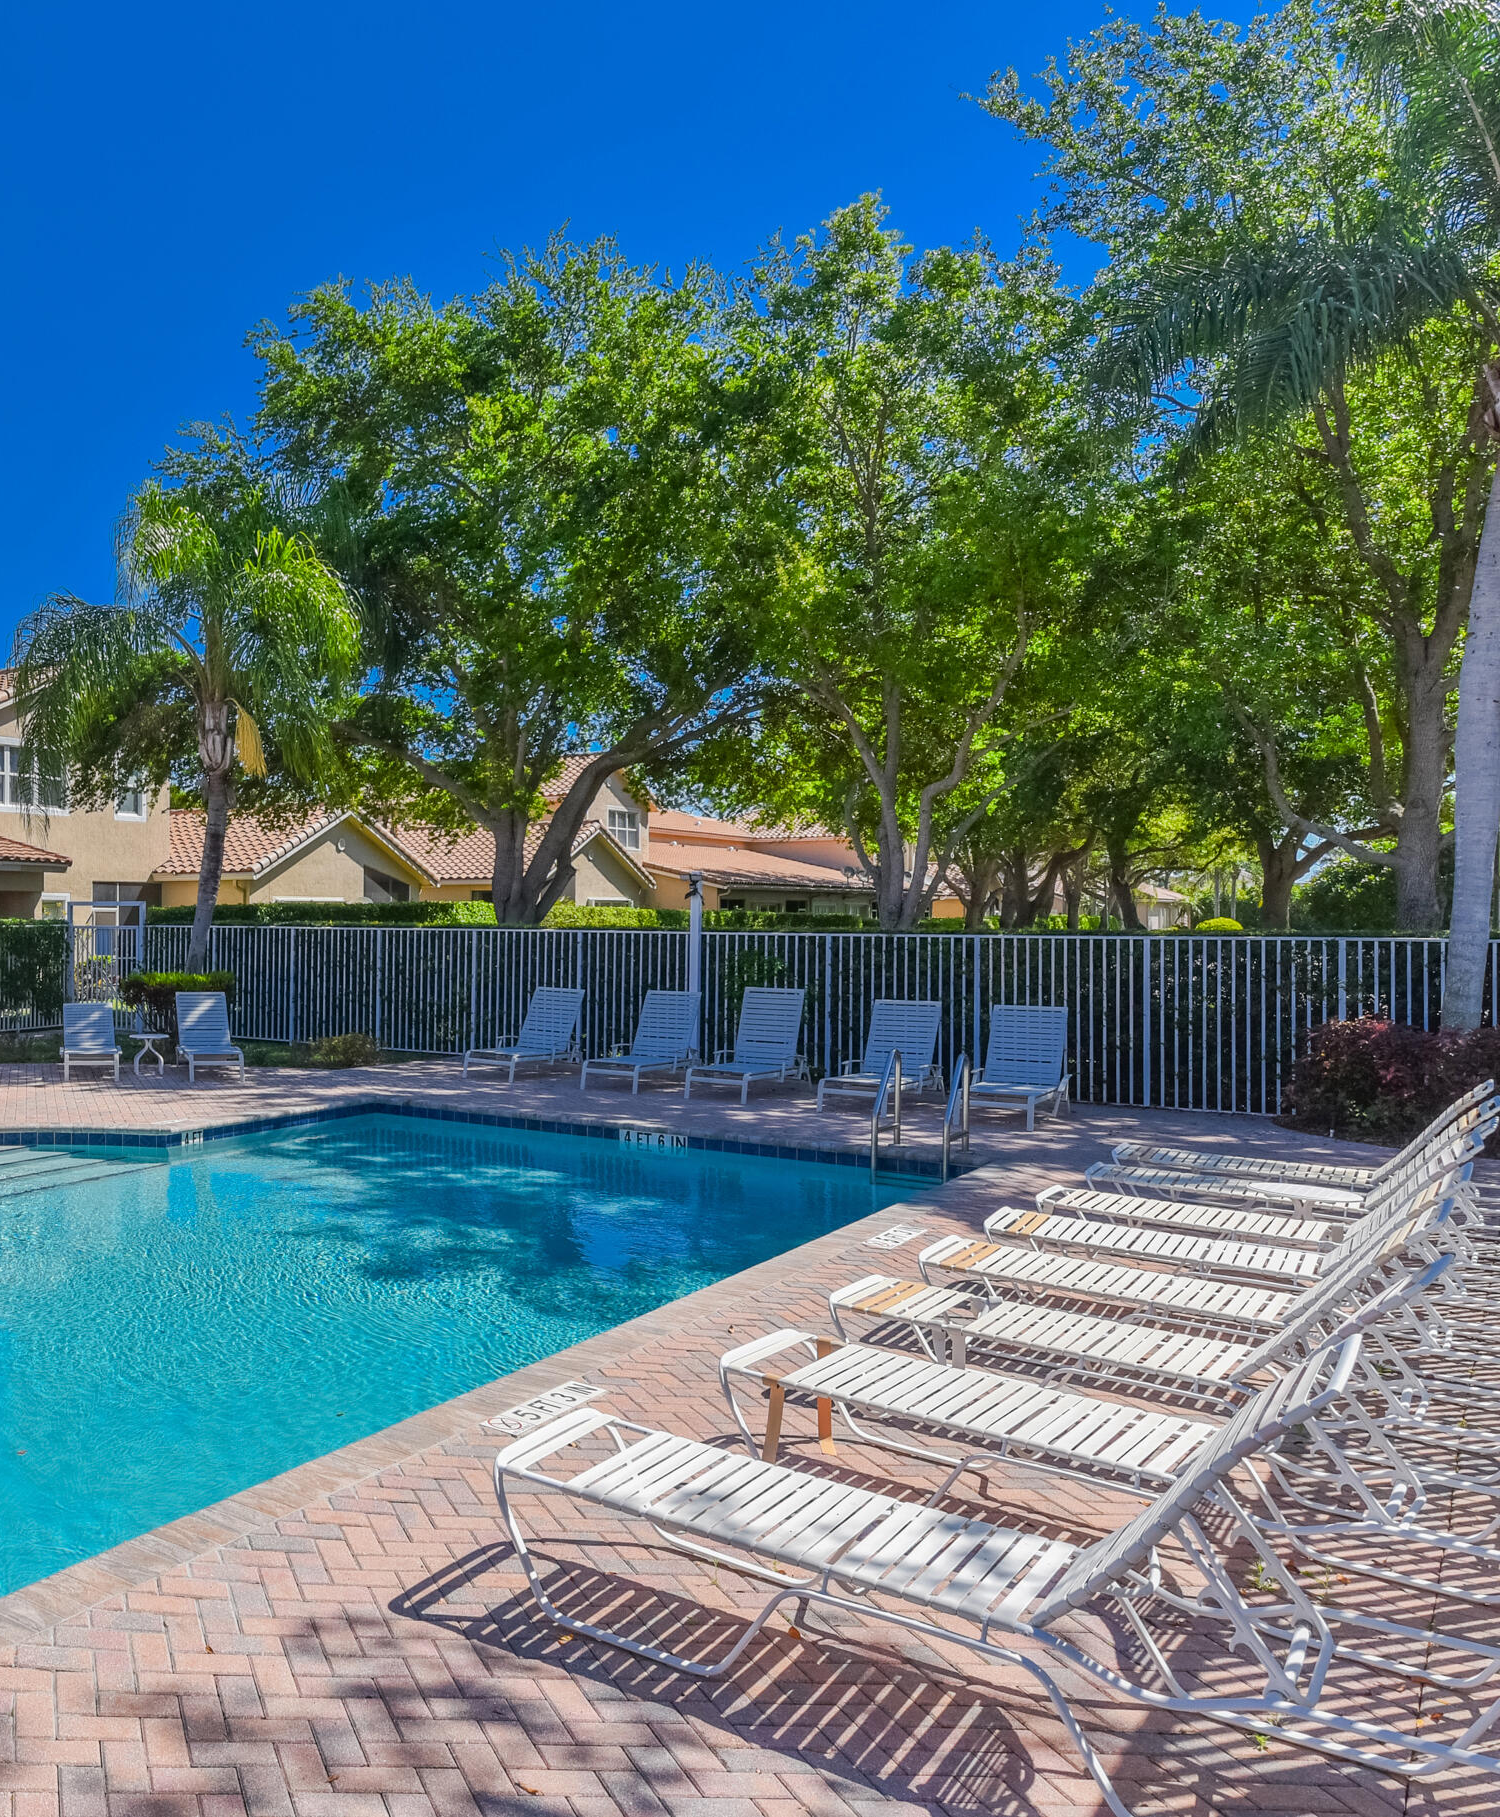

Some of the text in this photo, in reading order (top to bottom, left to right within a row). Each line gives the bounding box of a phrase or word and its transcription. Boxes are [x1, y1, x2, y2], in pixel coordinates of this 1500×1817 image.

[192, 1131, 203, 1144] FT
[624, 1131, 686, 1148] 4 FT 6 IN
[512, 1383, 598, 1421] 5 FT 3 IN
